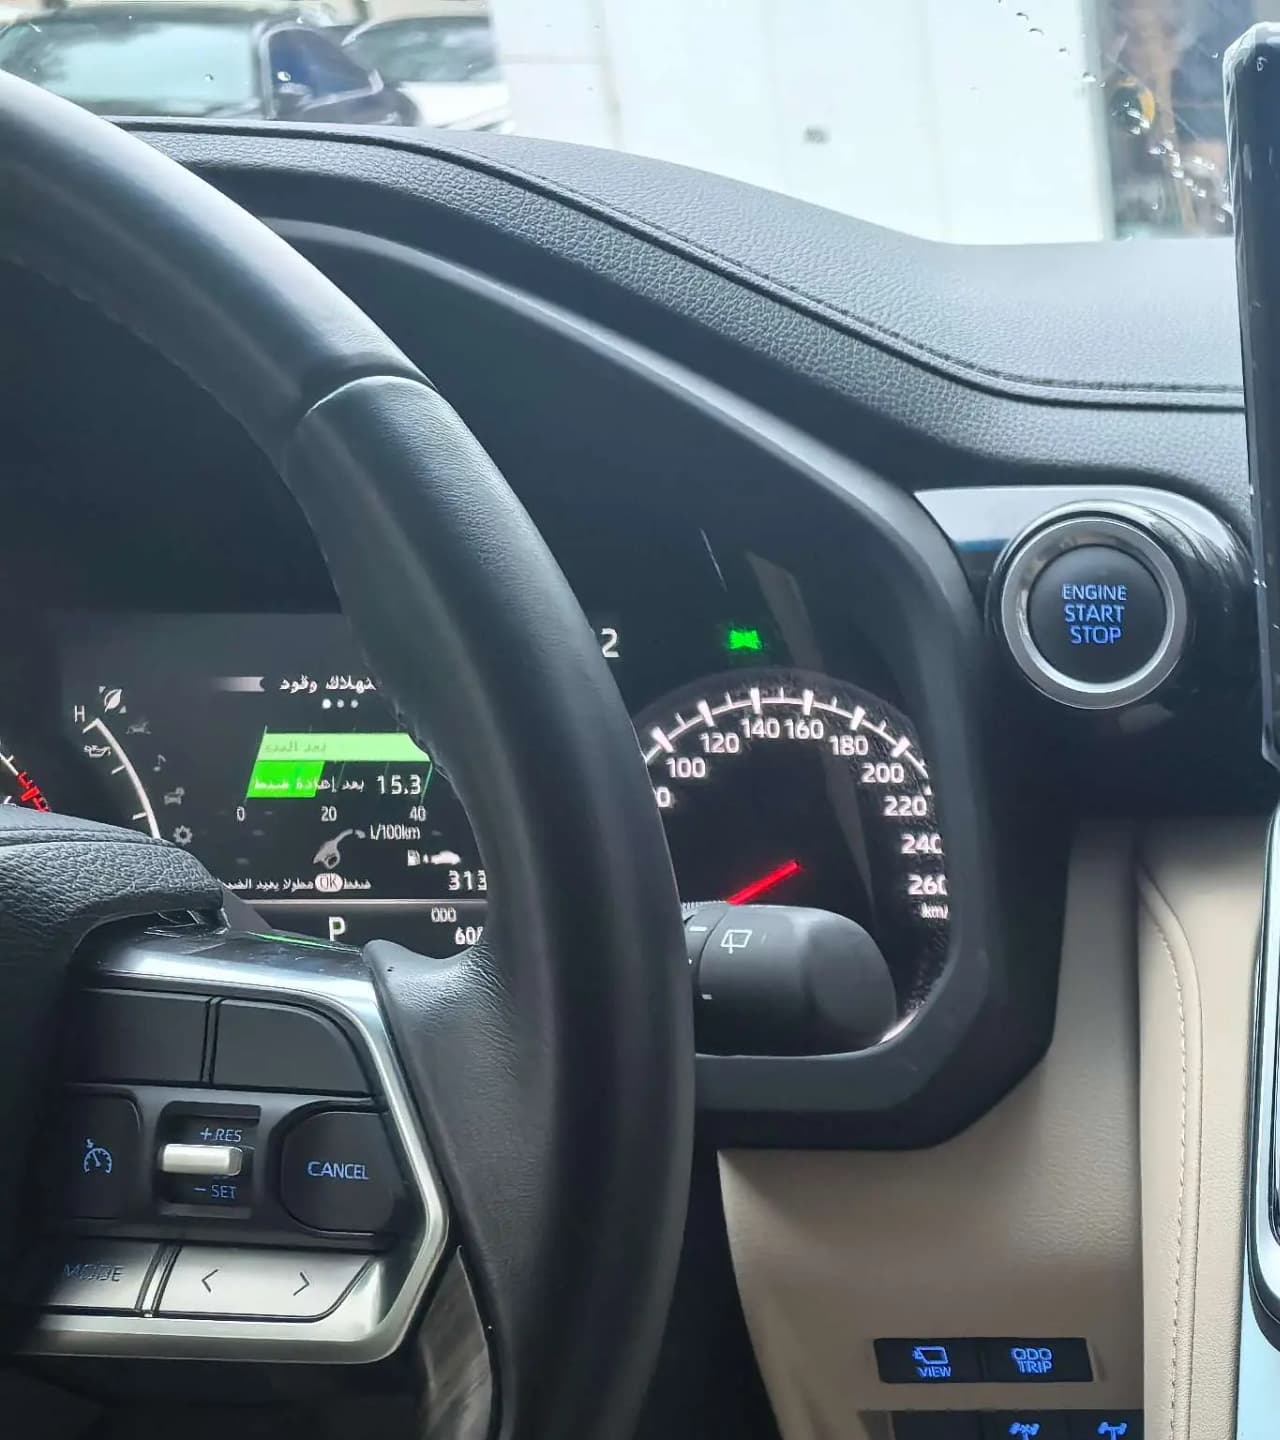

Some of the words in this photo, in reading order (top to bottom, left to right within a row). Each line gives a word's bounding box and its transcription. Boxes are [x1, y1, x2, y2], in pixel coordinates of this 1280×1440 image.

[1062, 584, 1127, 600] ENGINE
[1064, 604, 1124, 622] START
[1070, 626, 1121, 643] STOP
[74, 705, 86, 722] H
[741, 718, 780, 739] 140
[785, 718, 824, 740] 160
[700, 733, 740, 754] 120
[829, 735, 869, 757] 180
[666, 757, 707, 779] 100
[861, 763, 905, 783] 200
[376, 775, 423, 796] 15.3
[236, 806, 246, 823] 0
[321, 806, 338, 823] 20
[409, 806, 427, 823] 40
[883, 795, 928, 817] 220
[901, 833, 943, 855] 240
[319, 876, 339, 890] OK
[328, 916, 346, 941] P
[308, 1160, 369, 1180] CANCEL
[211, 1184, 237, 1200] SET
[1012, 1347, 1052, 1360] ODO
[917, 1366, 951, 1377] VIEW
[1017, 1362, 1052, 1373] TRIP
